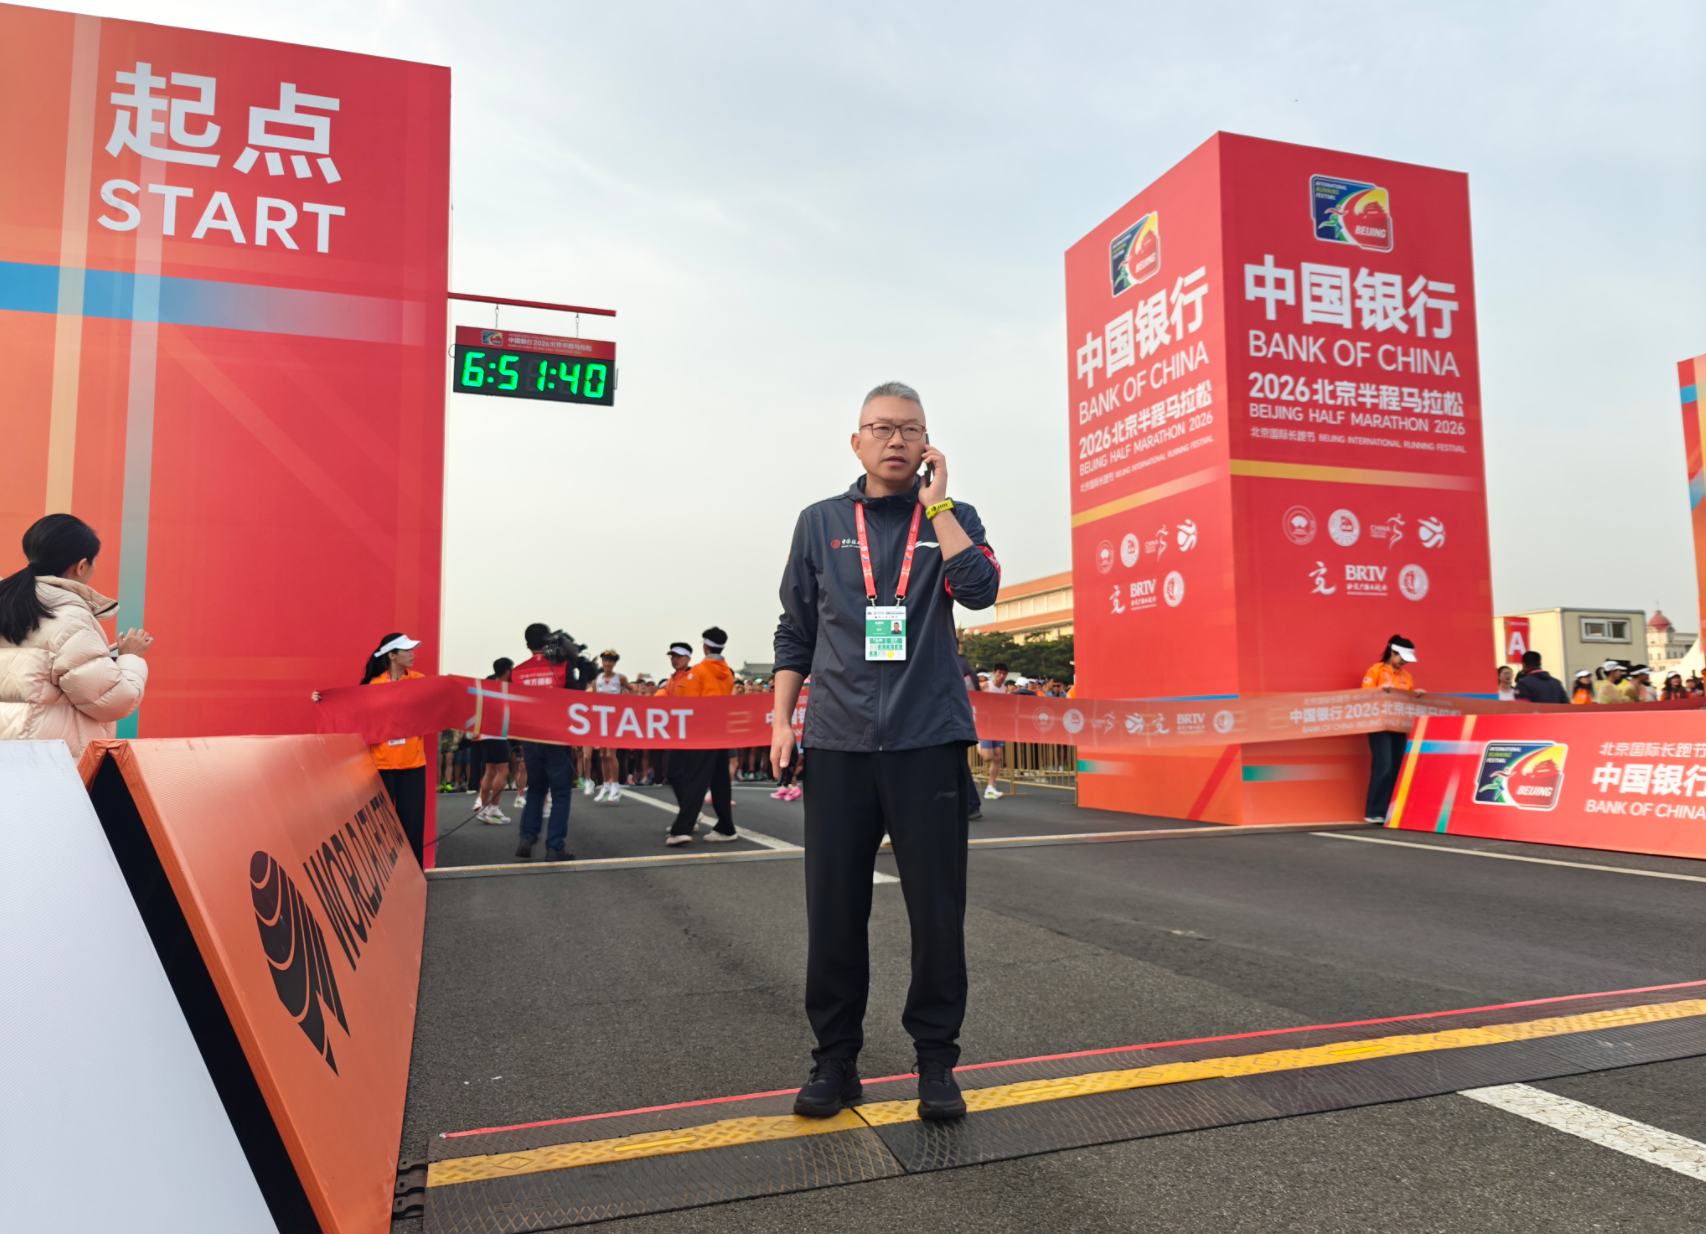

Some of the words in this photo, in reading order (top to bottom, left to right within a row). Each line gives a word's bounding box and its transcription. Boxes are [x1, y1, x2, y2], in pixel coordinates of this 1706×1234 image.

[104, 61, 342, 184] 起点
[97, 178, 346, 253] START
[1355, 225, 1387, 238] BEIJING
[1244, 254, 1459, 339] 中国银行
[1077, 265, 1208, 389] 中国银行
[1249, 329, 1327, 364] BANK
[1333, 339, 1371, 368] OF
[1377, 344, 1460, 378] CHINA
[1079, 383, 1121, 426] BANK
[1123, 369, 1147, 403] OF
[1150, 340, 1209, 389] CHINA
[1248, 371, 1465, 418] 2026北京半程马拉松
[1078, 378, 1213, 460] 2026北京半程马拉松
[1249, 403, 1303, 421] BEIJING
[1308, 408, 1346, 425] HALF
[1350, 411, 1429, 433] MARATHON
[1434, 419, 1466, 436] 2026
[1079, 453, 1108, 476] BEIJING
[1109, 443, 1131, 464] HALF
[1133, 420, 1186, 455] MARATHON
[1188, 409, 1214, 432] 2026
[1250, 426, 1316, 443] 北京国际长跑节
[1318, 433, 1346, 444] BEIJING
[1347, 435, 1402, 448] INTERNATIONAL
[1403, 440, 1435, 451] RUNNING
[1436, 443, 1467, 453] FESTIVAL
[1130, 578, 1156, 598] BRTV
[1345, 564, 1388, 582] BRTV
[1508, 631, 1527, 655] A
[568, 703, 694, 739] START
[1177, 713, 1206, 724] BRTV
[1289, 705, 1343, 725] 中国银行
[1598, 742, 1706, 758] 北京国际长跑节
[1516, 785, 1554, 797] BEIJING
[1591, 761, 1706, 797] 中国银行
[1585, 799, 1629, 815] BANK
[1629, 802, 1654, 816] OF
[1655, 803, 1706, 820] CHINA
[302, 821, 383, 972] WORLD
